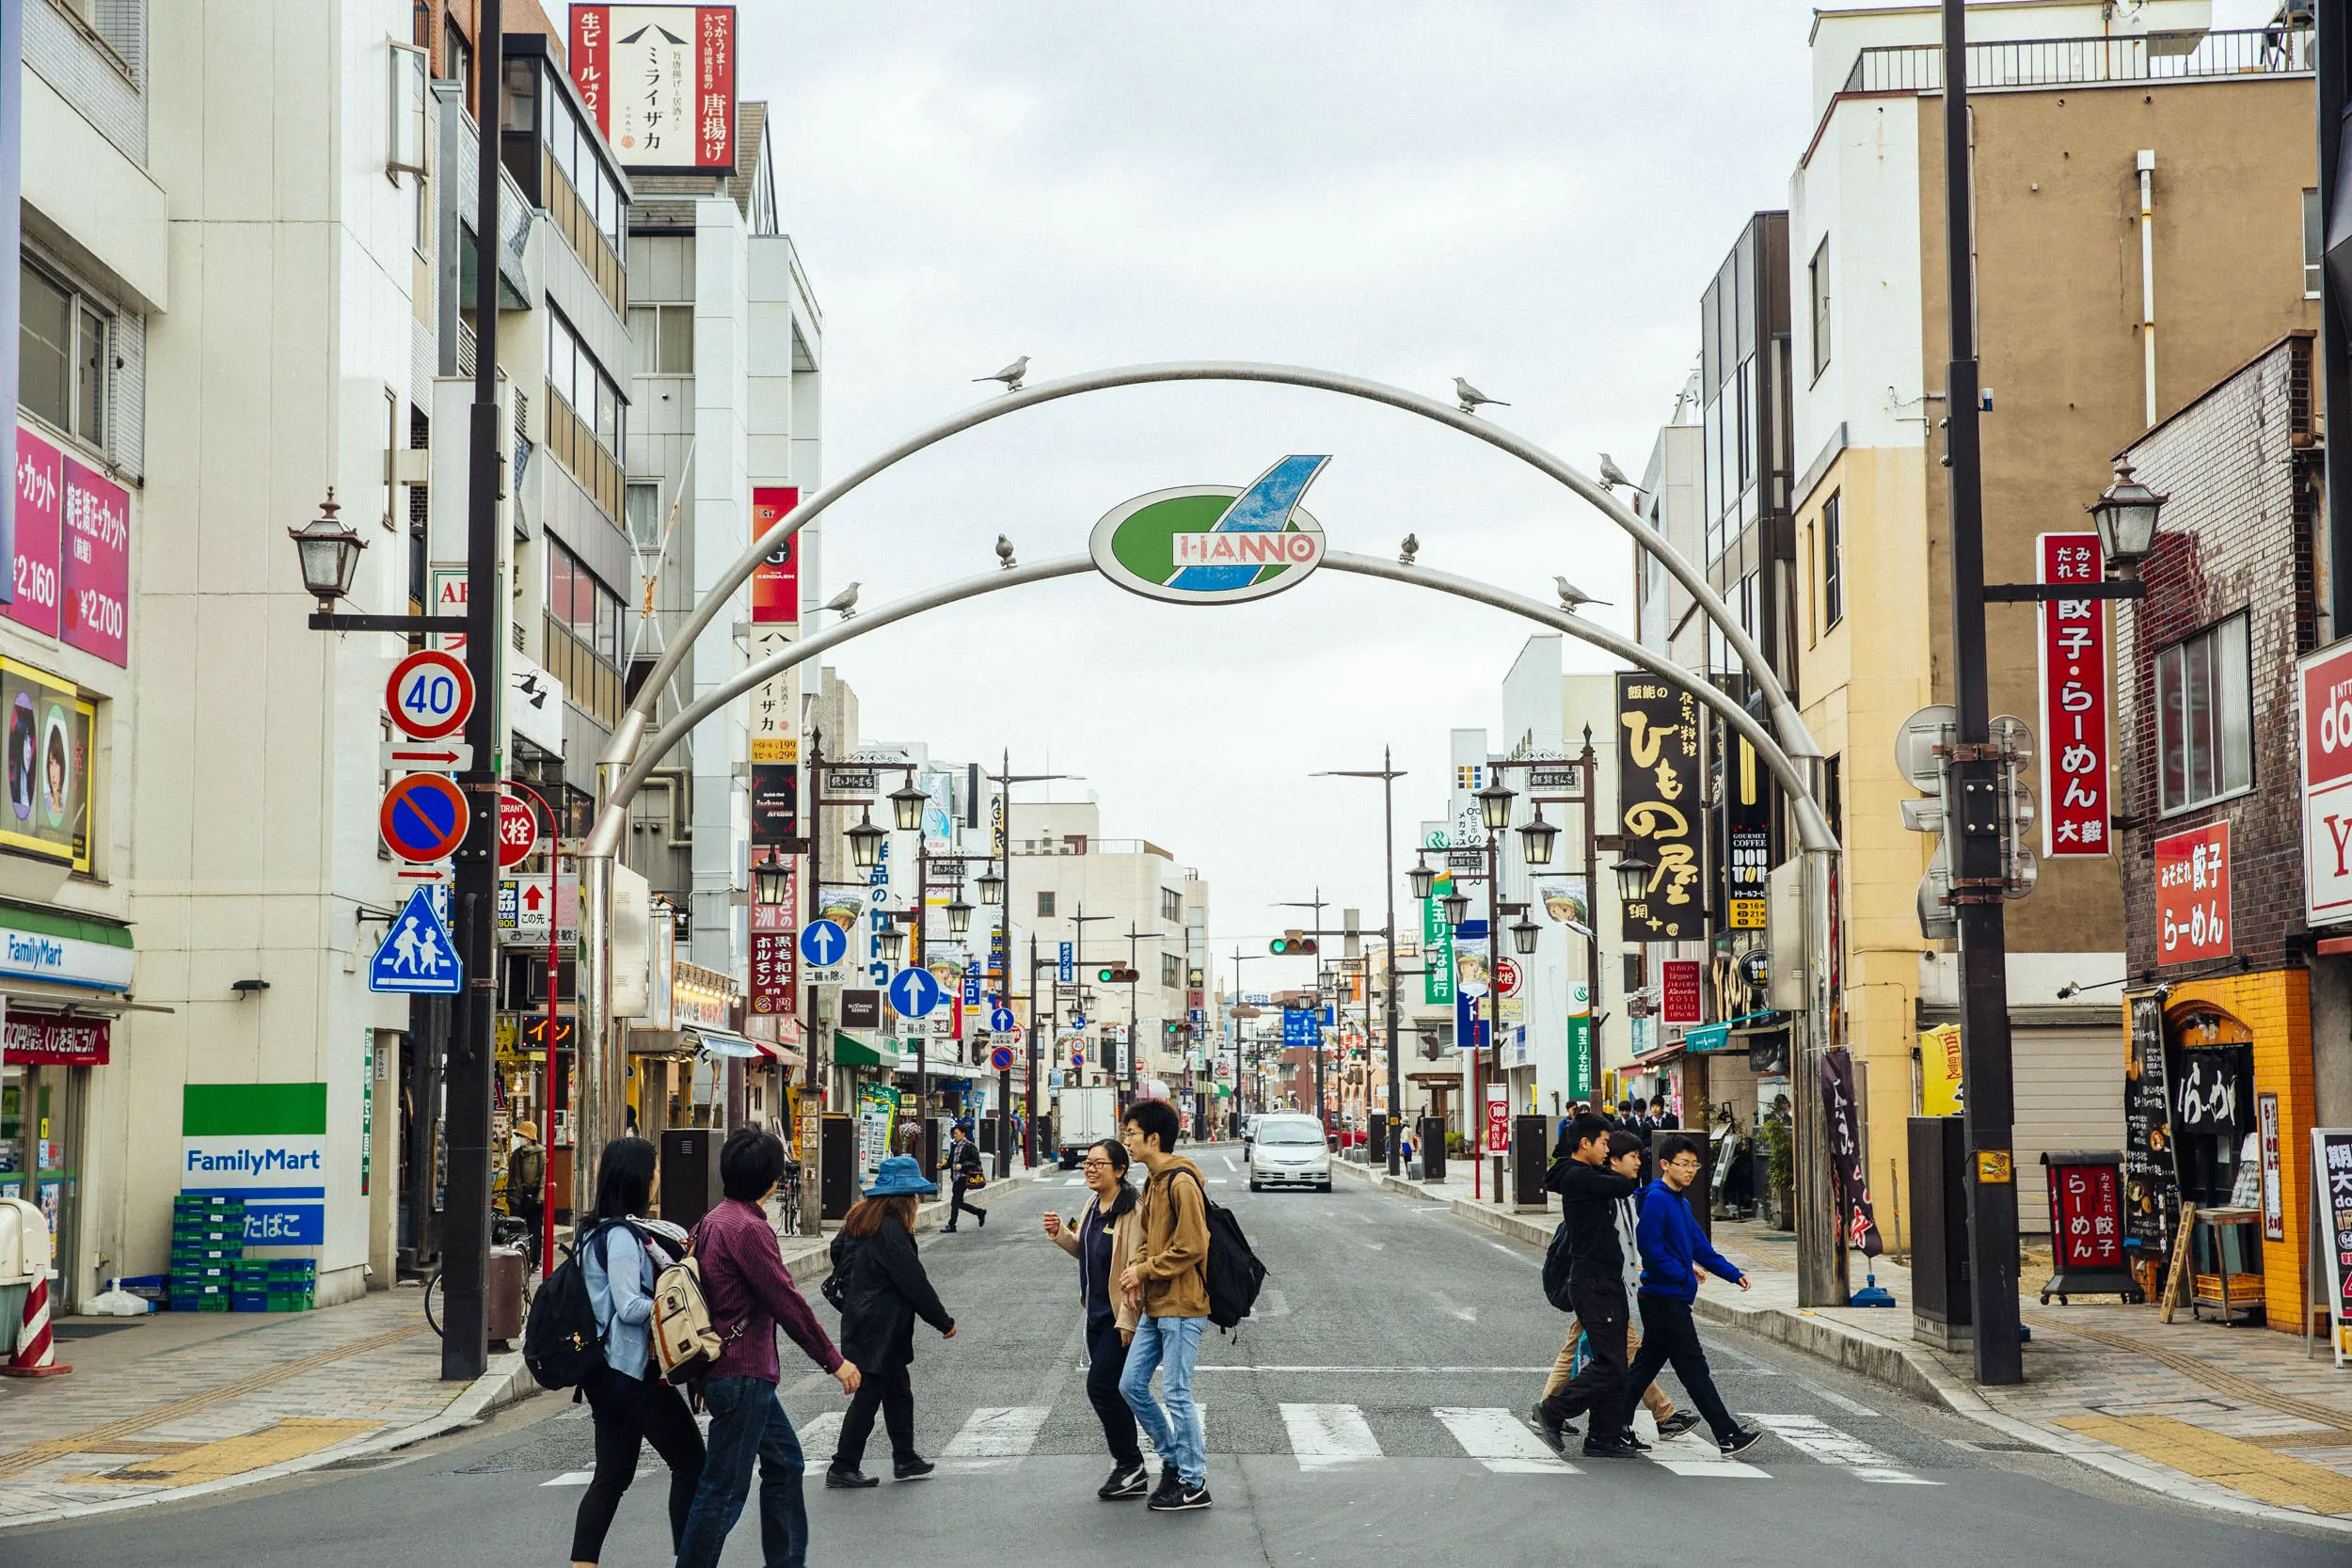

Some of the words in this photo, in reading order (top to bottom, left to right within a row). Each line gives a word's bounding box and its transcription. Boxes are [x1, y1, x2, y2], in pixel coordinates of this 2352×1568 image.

[643, 46, 662, 150] ミライザカ
[703, 93, 726, 162] 唐揚げ
[15, 451, 56, 513] +カット
[1181, 534, 1314, 562] HANNO
[2058, 546, 2073, 578] だれ
[2075, 546, 2091, 578] みそ
[81, 589, 123, 641] ¥2,700
[405, 675, 453, 715] 40
[760, 647, 776, 732] ミイザカ
[1628, 686, 1669, 700] 飯能の
[1620, 710, 1698, 906] ひもの屋
[1733, 848, 1767, 865] DOU
[521, 913, 545, 924] この先
[2164, 899, 2223, 952] らーめん
[8, 934, 62, 970] FamilyMart
[756, 936, 771, 986] ホルモン
[774, 936, 792, 986] 黒毛和牛
[804, 971, 845, 982] 二輪を除く
[1752, 970, 1767, 979] TO
[1578, 1026, 1589, 1092] 埼玉りそな銀行
[1493, 1106, 1505, 1117] 100
[187, 1148, 320, 1176] FamilyMart
[243, 1212, 301, 1238] たばこ
[2069, 1174, 2092, 1259] らーめん
